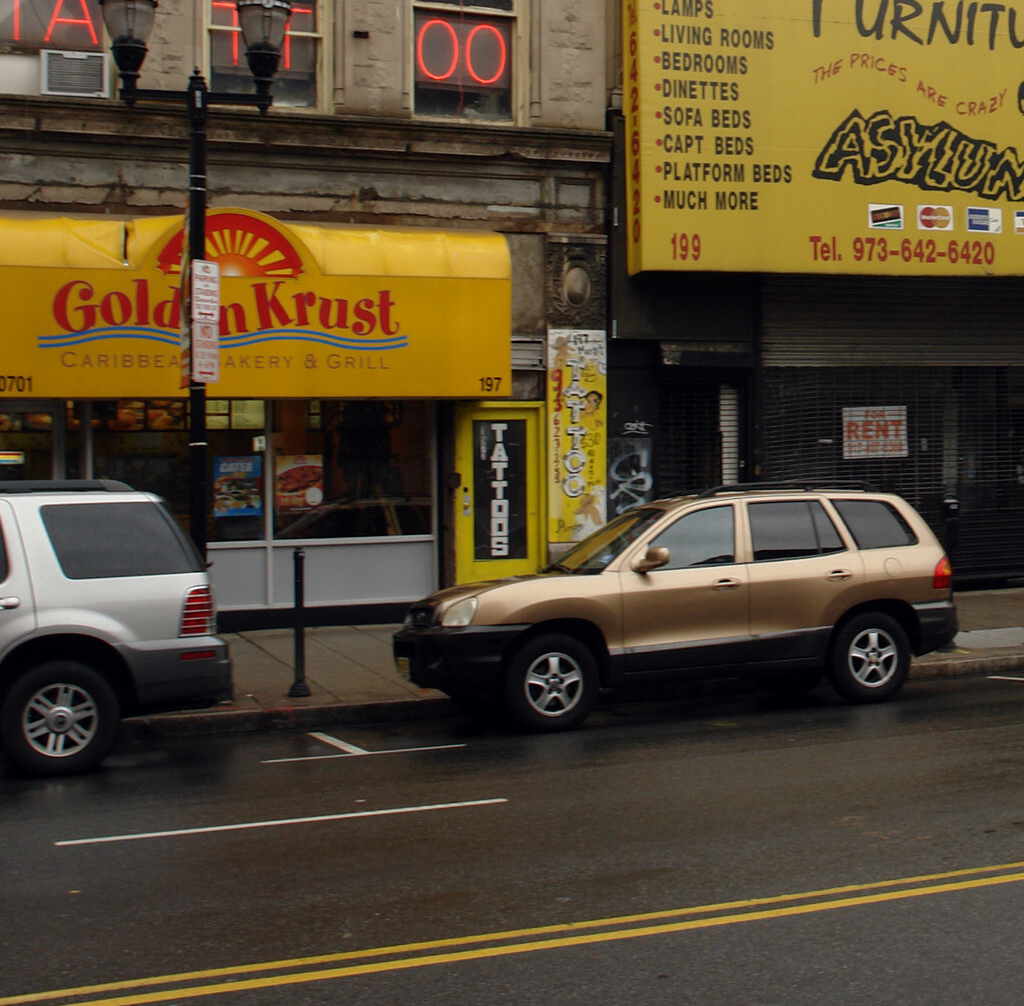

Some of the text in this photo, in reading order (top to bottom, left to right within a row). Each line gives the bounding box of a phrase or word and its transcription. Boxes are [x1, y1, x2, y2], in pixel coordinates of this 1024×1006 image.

[661, 24, 774, 50] LIVING ROOMS
[661, 51, 748, 75] BEDROOMS
[662, 78, 739, 101] DINETTES
[812, 53, 1007, 116] THE PRICES ARE CRAZY
[663, 106, 752, 130] SOFA BEDS
[663, 134, 754, 156] CAPT BEDS
[663, 161, 792, 184] PLATFORM BEDS
[663, 190, 759, 211] MUCH MORE
[671, 233, 701, 261] 199
[809, 236, 995, 265] Tel. 973-642-6420
[52, 279, 249, 336] Goldn
[251, 281, 400, 336] Krust
[61, 351, 181, 368] CARIBBEA
[218, 355, 293, 369] AKERY
[303, 354, 318, 369] &
[327, 354, 390, 369] GRILL
[478, 377, 501, 392] 197
[563, 357, 588, 499] TATTOO
[846, 420, 903, 440] RENT
[490, 423, 509, 556] TATTOOS
